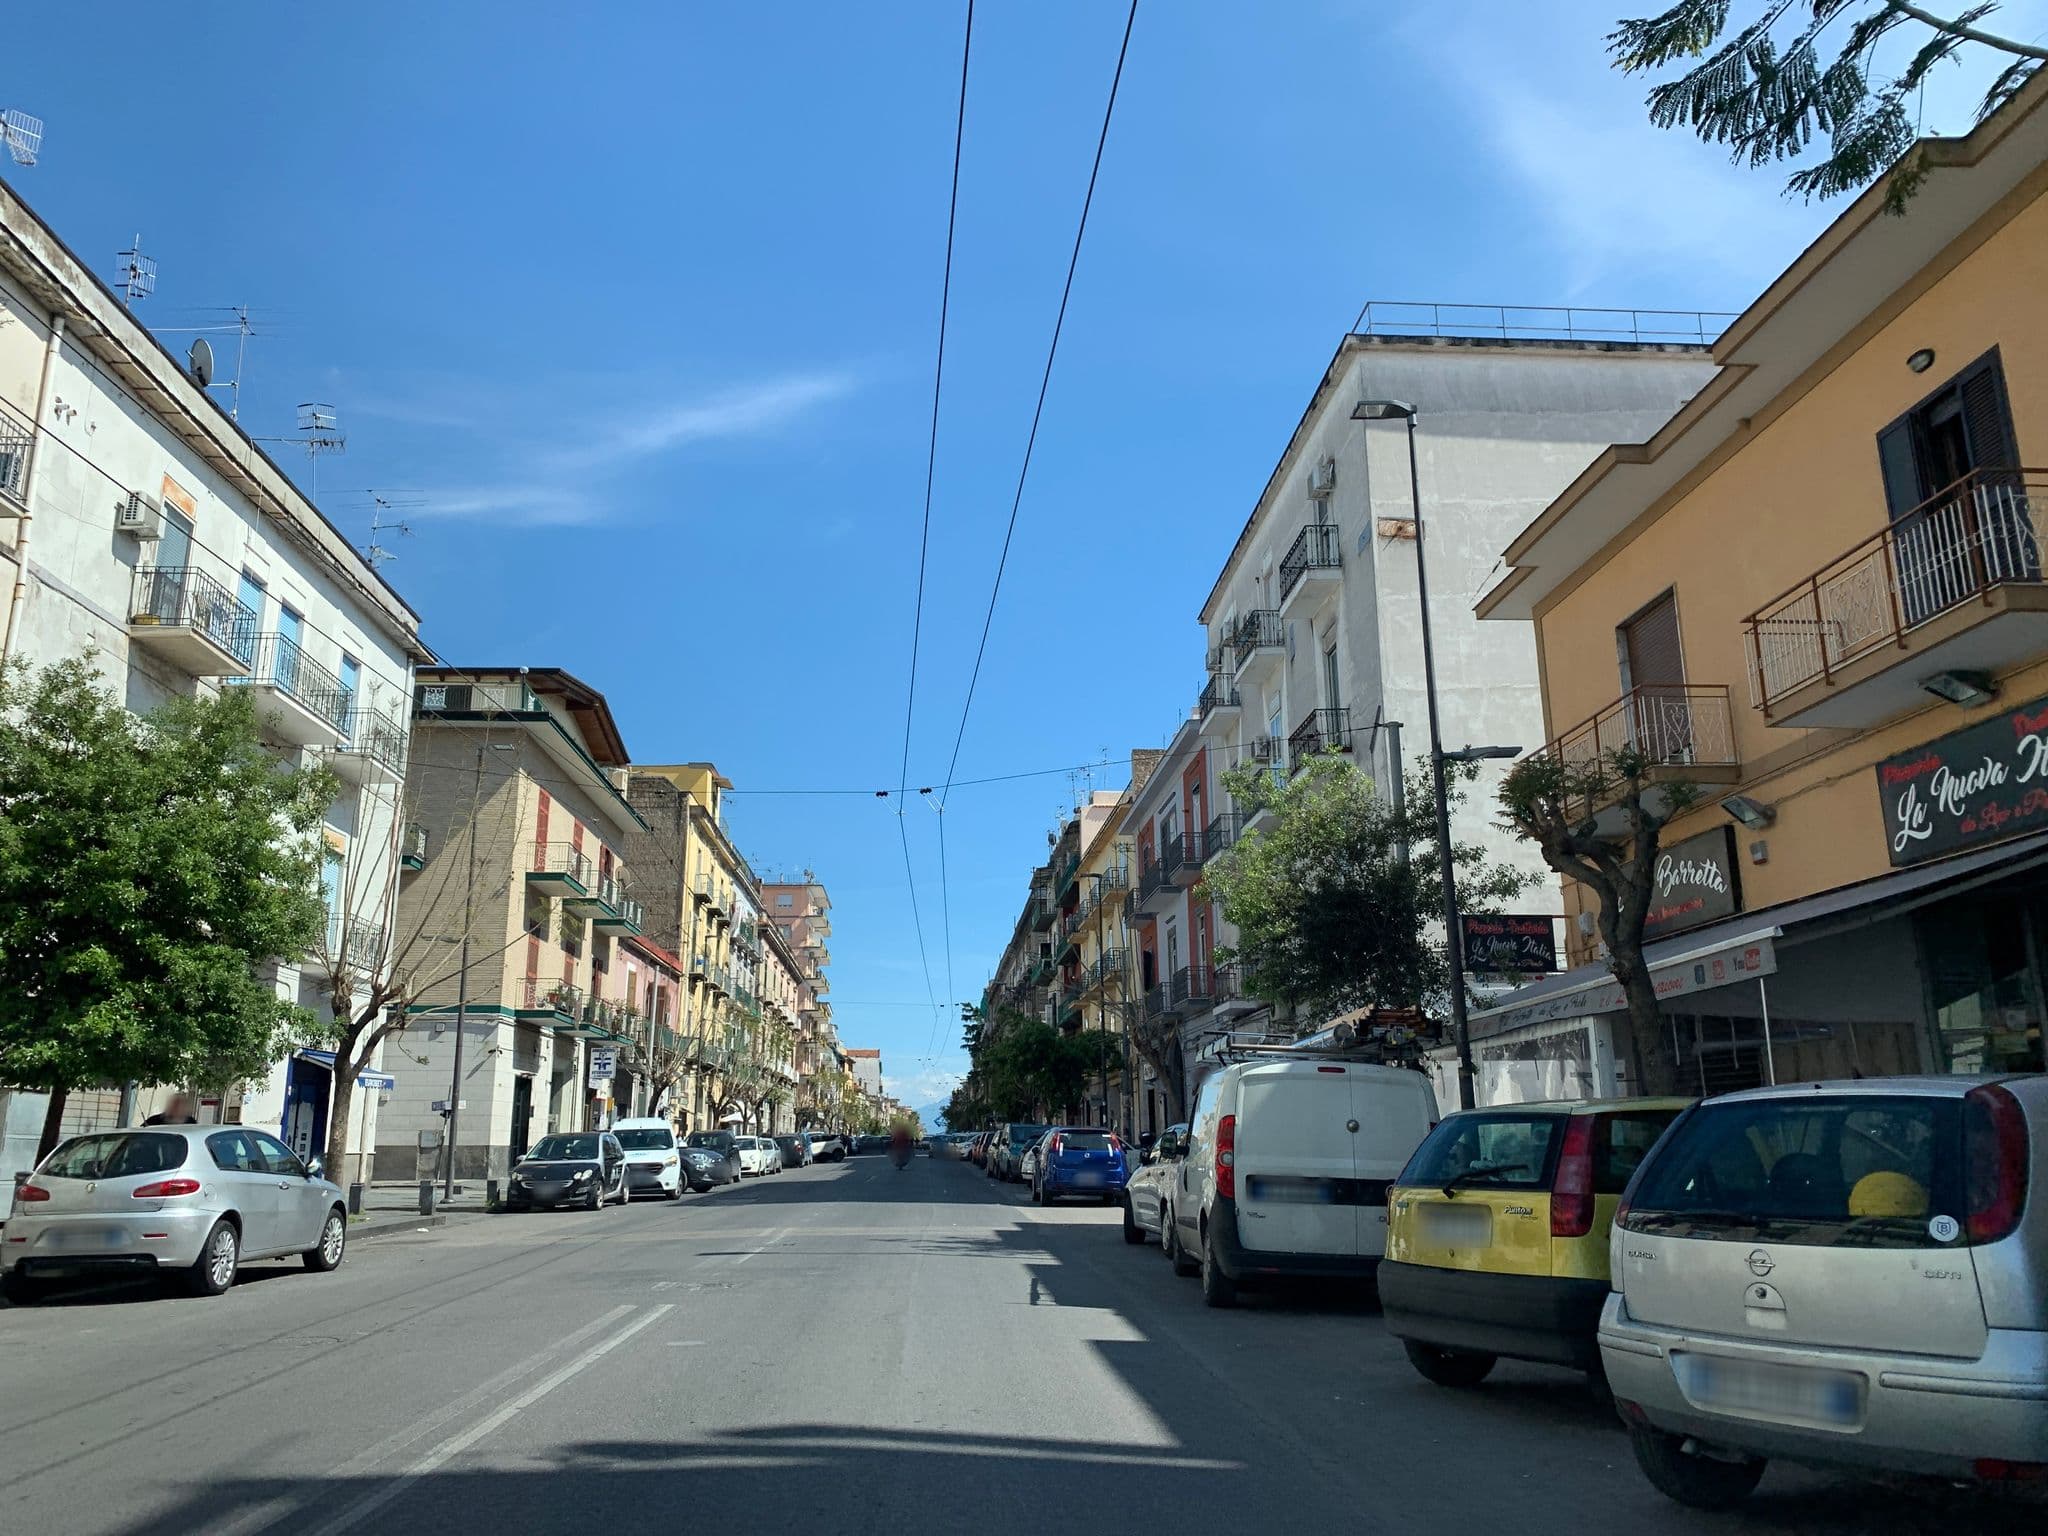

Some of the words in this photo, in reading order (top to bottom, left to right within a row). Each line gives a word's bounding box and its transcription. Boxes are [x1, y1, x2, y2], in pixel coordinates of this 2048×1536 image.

[1894, 783, 1933, 852] La
[1930, 756, 2010, 816] Nuova
[1657, 854, 1728, 897] Barretta
[1522, 935, 1553, 960] Italia
